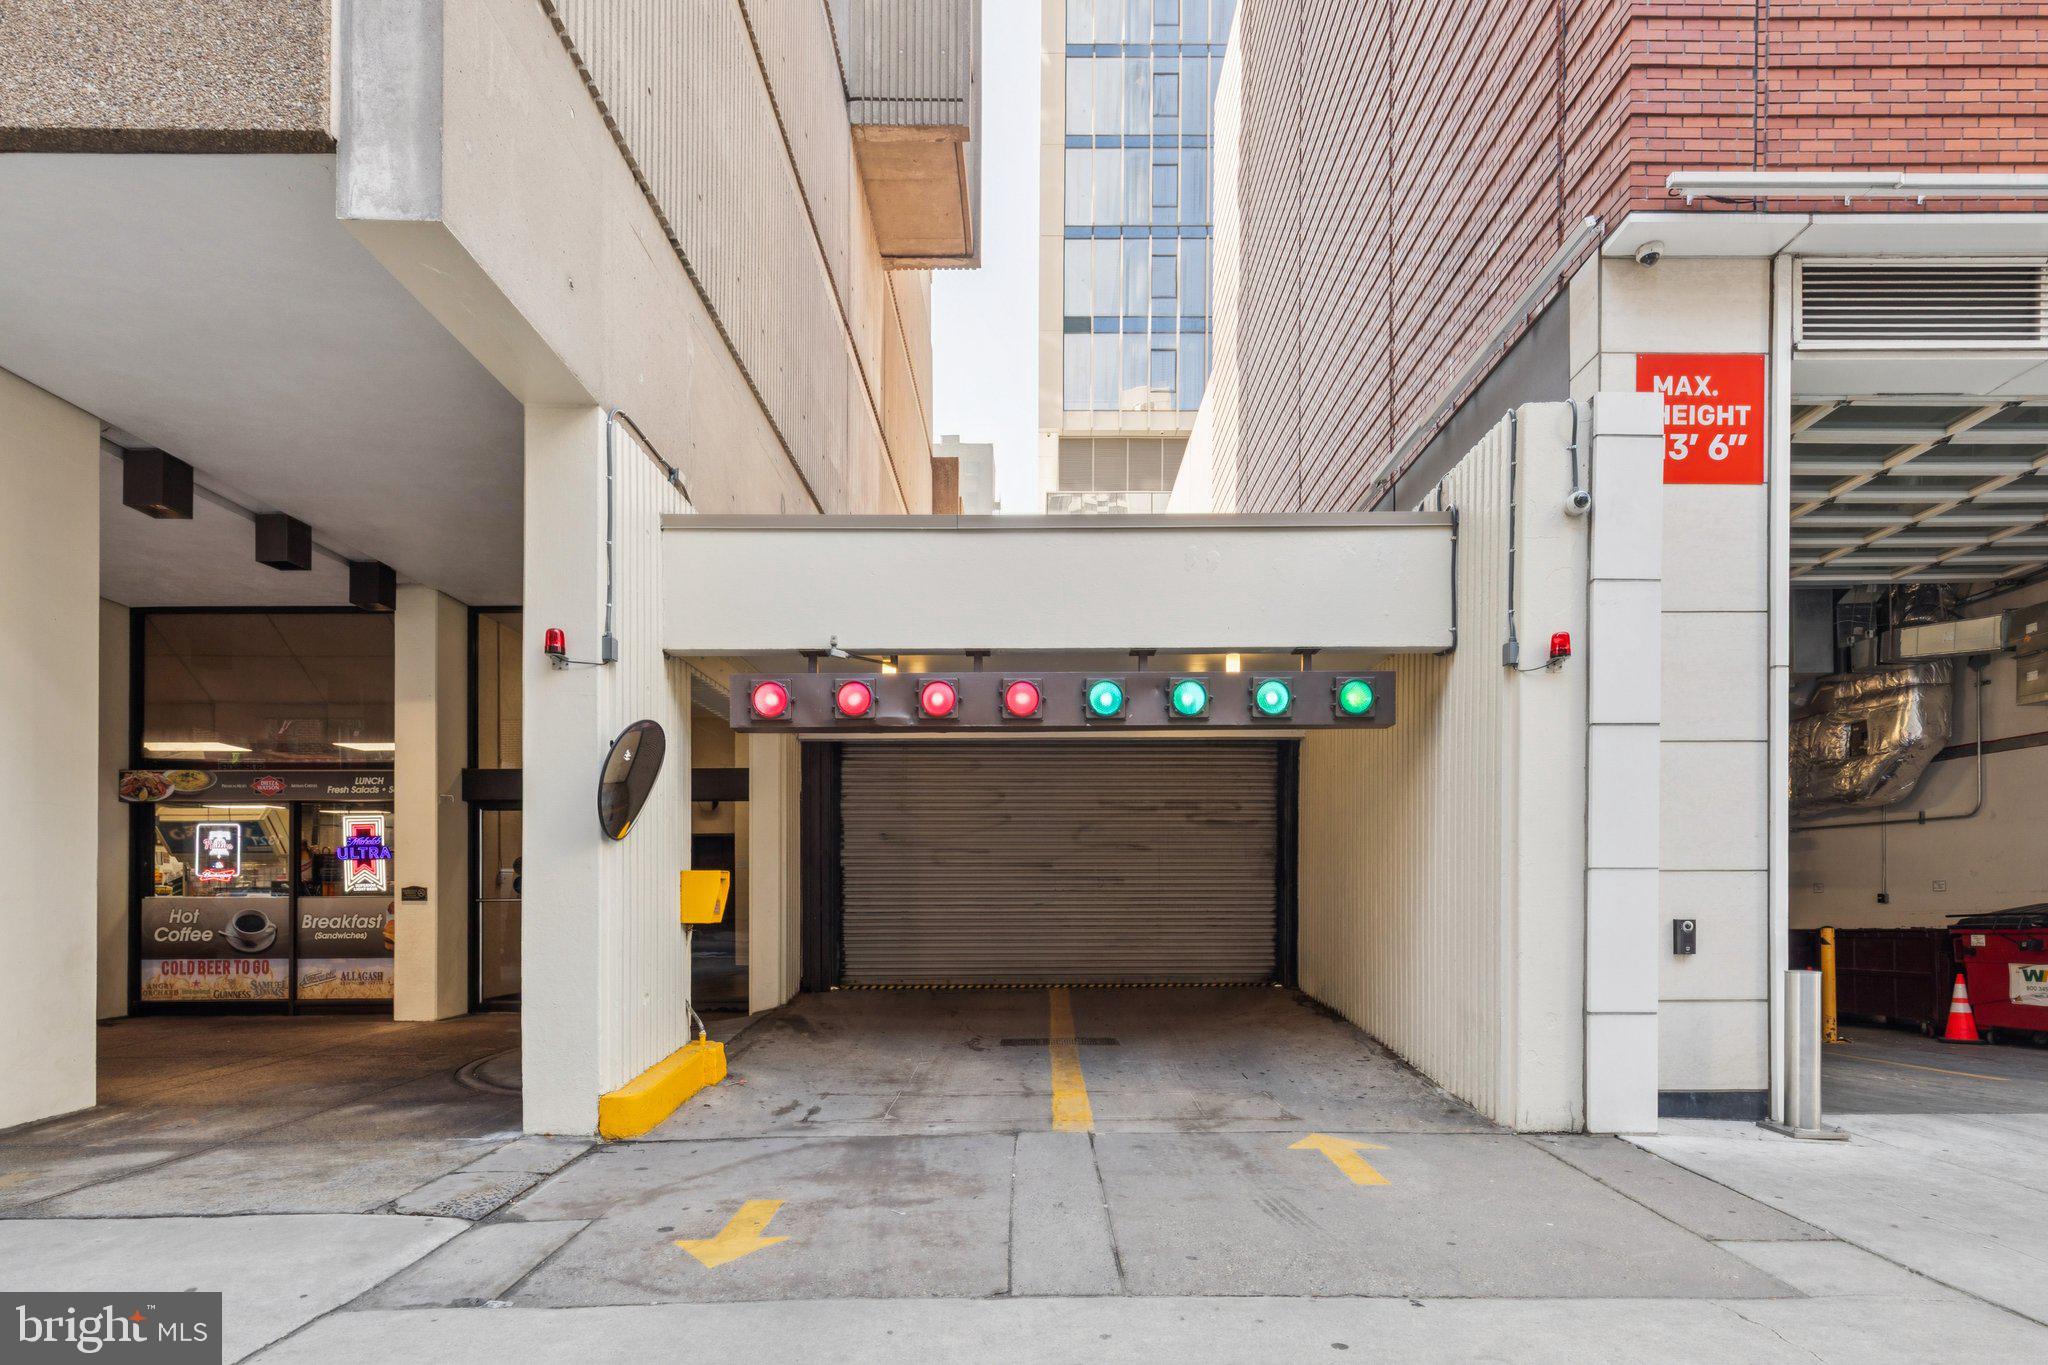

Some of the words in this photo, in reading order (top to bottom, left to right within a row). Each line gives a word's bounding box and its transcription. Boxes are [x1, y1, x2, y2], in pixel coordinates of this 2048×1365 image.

[1653, 375, 1719, 397] MAX.
[1664, 433, 1698, 461] 3'
[354, 777, 384, 785] LUNCH
[327, 786, 350, 794] Fresh
[351, 786, 379, 794] Salads
[388, 786, 395, 794] S
[336, 846, 392, 860] ULTRA
[168, 908, 200, 924] Hot
[302, 914, 383, 929] Breakfast
[154, 926, 214, 942] Coffee
[314, 931, 368, 940] (Sandwiches)
[161, 960, 195, 975] COLD
[197, 960, 230, 975] BEER
[233, 960, 250, 975] TO
[252, 960, 270, 975] GO
[340, 971, 384, 981] ALLAGASH
[213, 989, 251, 999] GUINNESS
